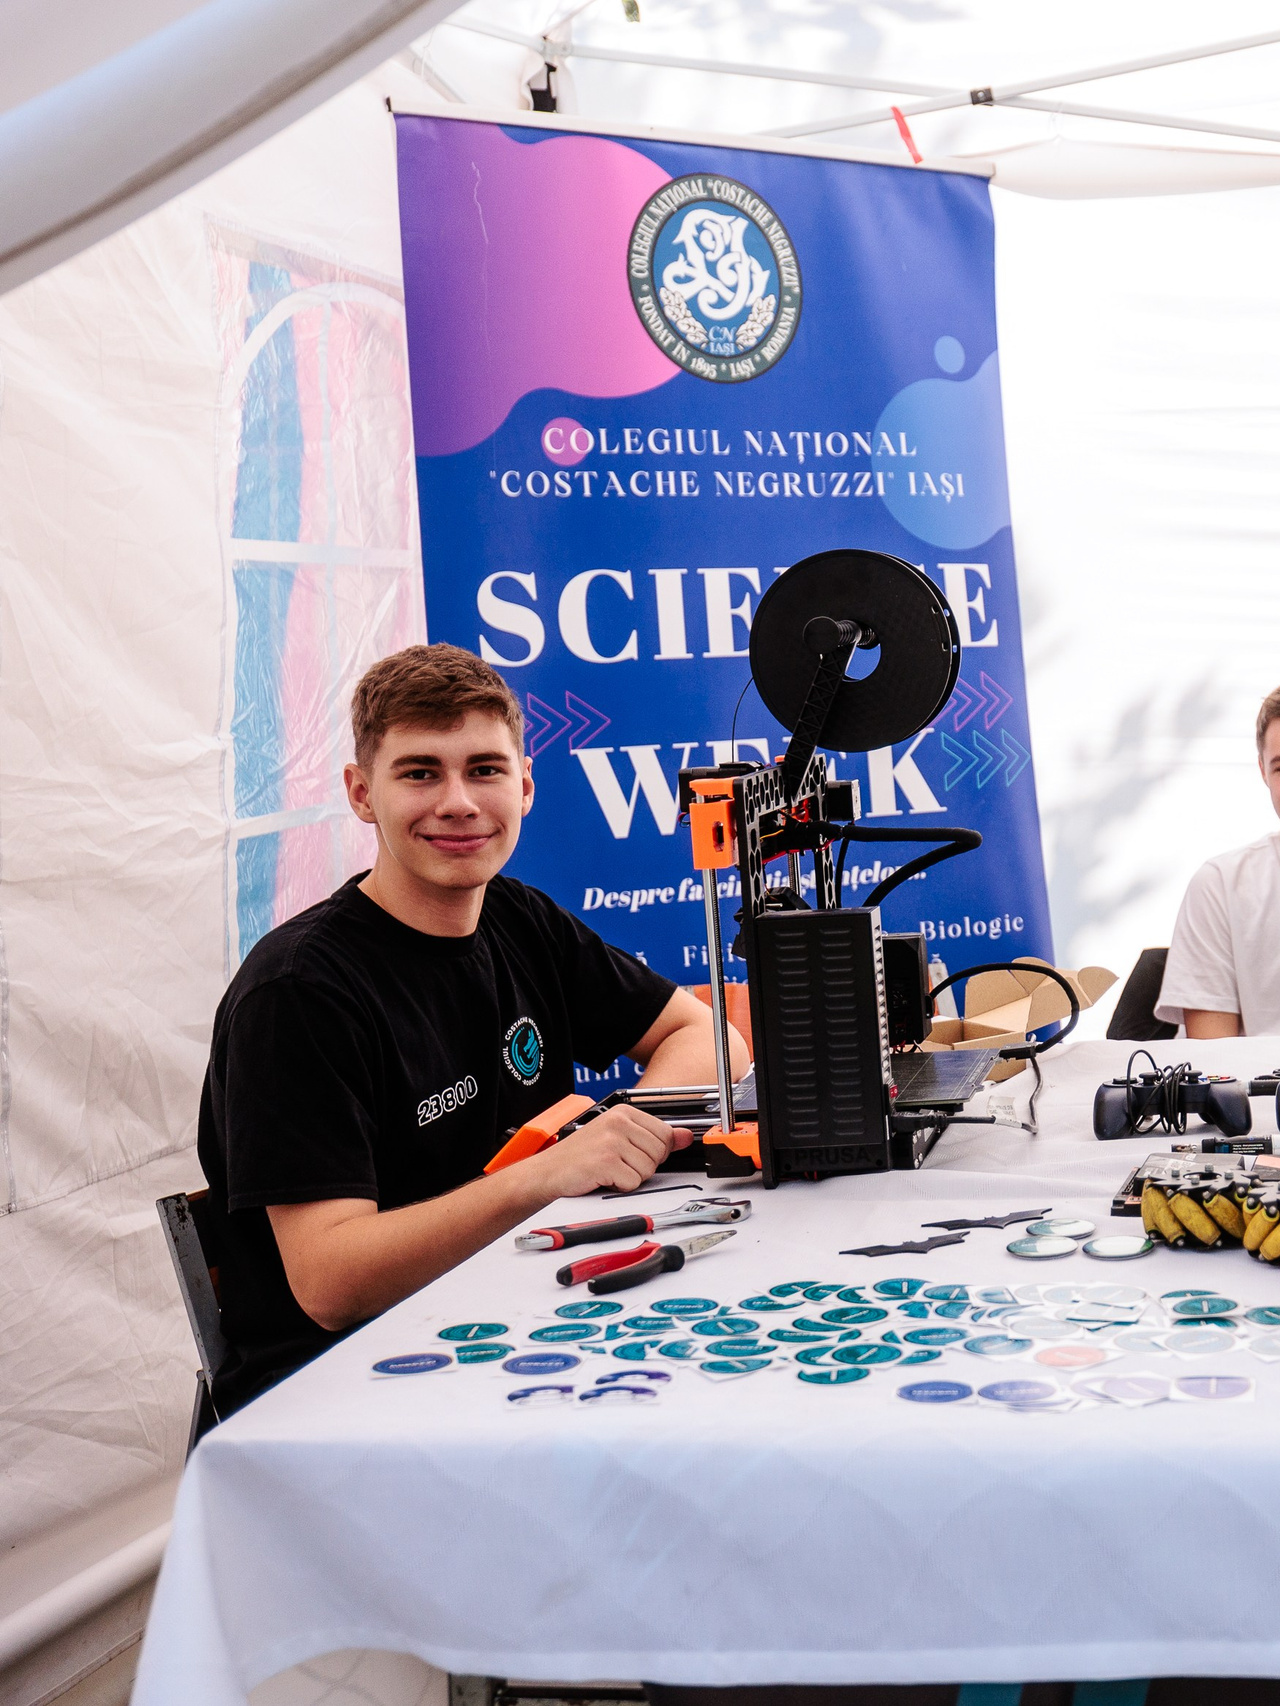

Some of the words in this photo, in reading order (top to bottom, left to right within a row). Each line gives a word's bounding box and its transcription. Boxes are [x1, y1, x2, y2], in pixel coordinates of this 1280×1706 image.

[630, 213, 660, 279] COLEGIUL
[638, 295, 673, 344] FONDAT
[671, 338, 691, 363] ÎN
[690, 355, 718, 379] 1895
[543, 427, 730, 456] COLEGIUL
[744, 430, 919, 464] NAȚIONAL
[489, 469, 701, 498] "COSTACHE
[713, 470, 894, 499] NEGRUZZI"
[908, 472, 965, 504] IAȘI
[476, 562, 999, 667] SCIEE
[581, 886, 675, 914] Despre
[502, 1046, 522, 1081] COLEGIUL
[417, 1074, 479, 1127] 23800
